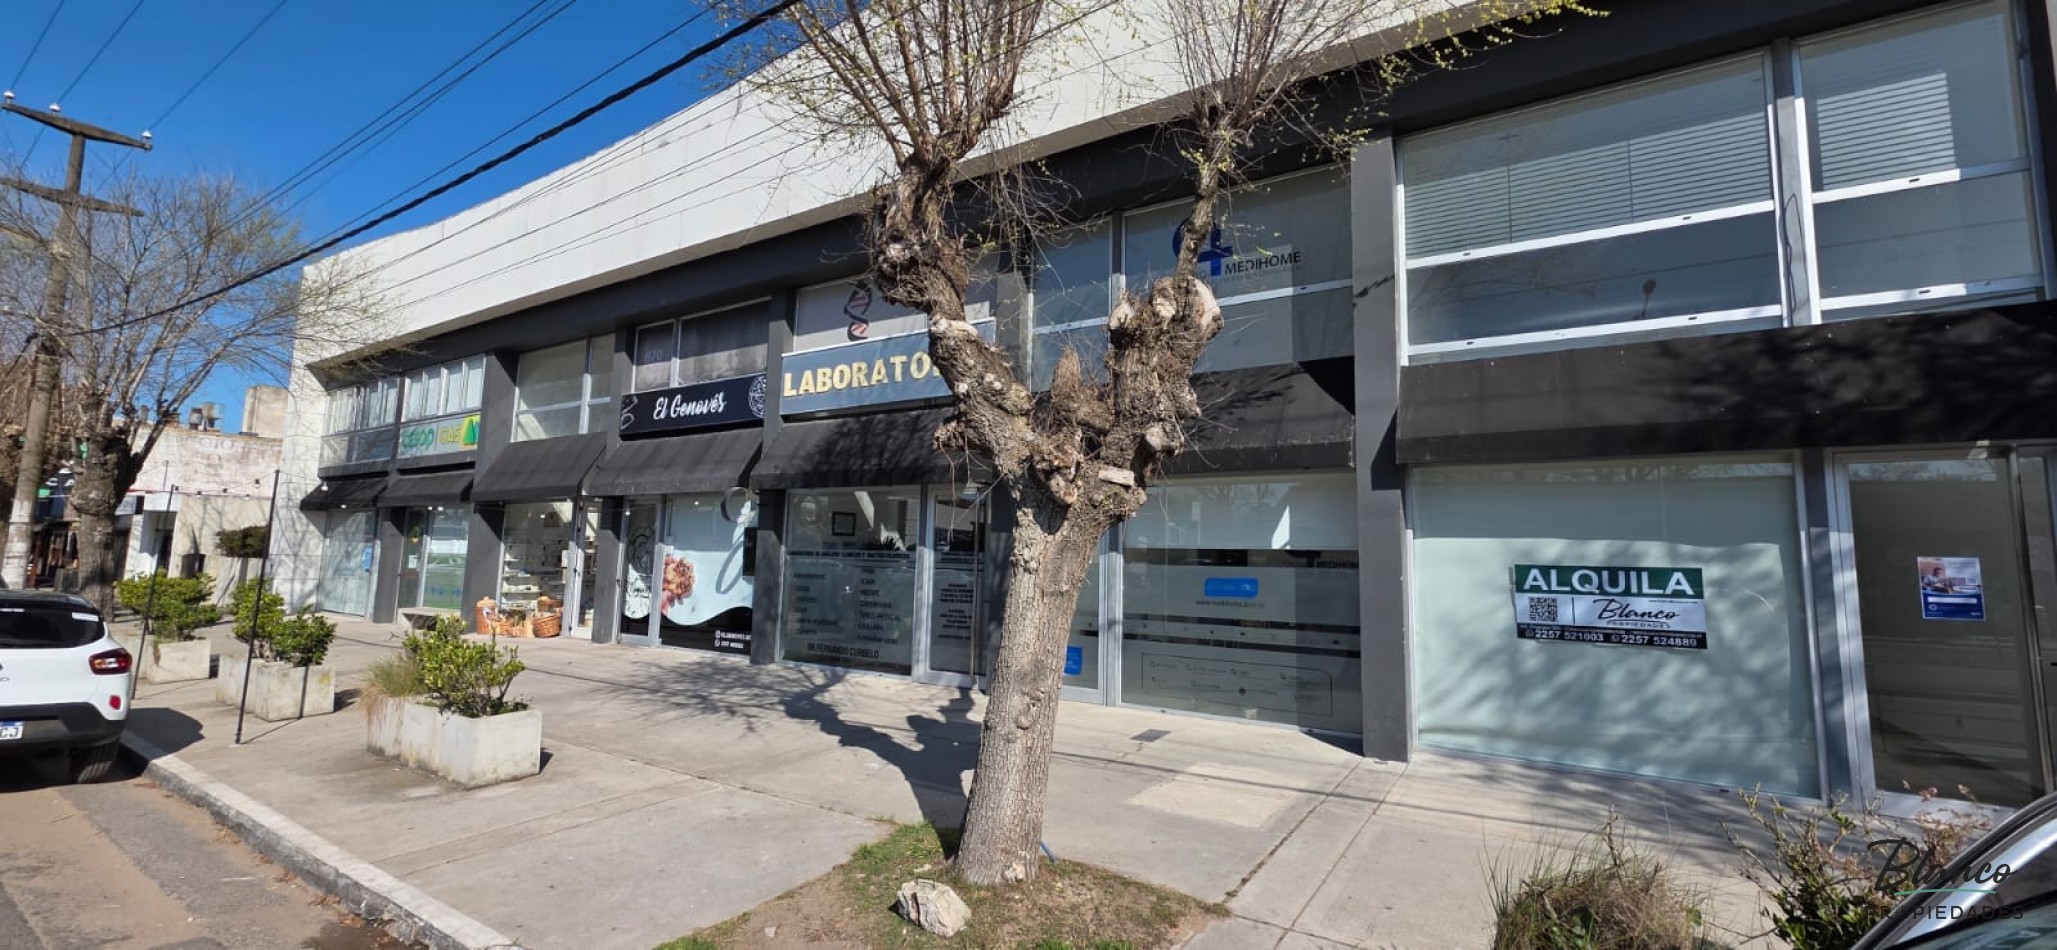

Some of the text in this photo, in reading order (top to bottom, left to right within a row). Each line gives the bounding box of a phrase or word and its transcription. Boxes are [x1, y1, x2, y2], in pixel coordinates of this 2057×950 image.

[1225, 251, 1302, 275] MEDIHOME
[783, 351, 941, 397] LABORATO
[653, 396, 668, 420] El
[1523, 567, 1694, 595] ALQUILA
[1592, 598, 1680, 620] Blanco
[1535, 630, 1560, 638] 2257
[1564, 632, 1604, 641] 521003
[1621, 635, 1649, 644] 2257
